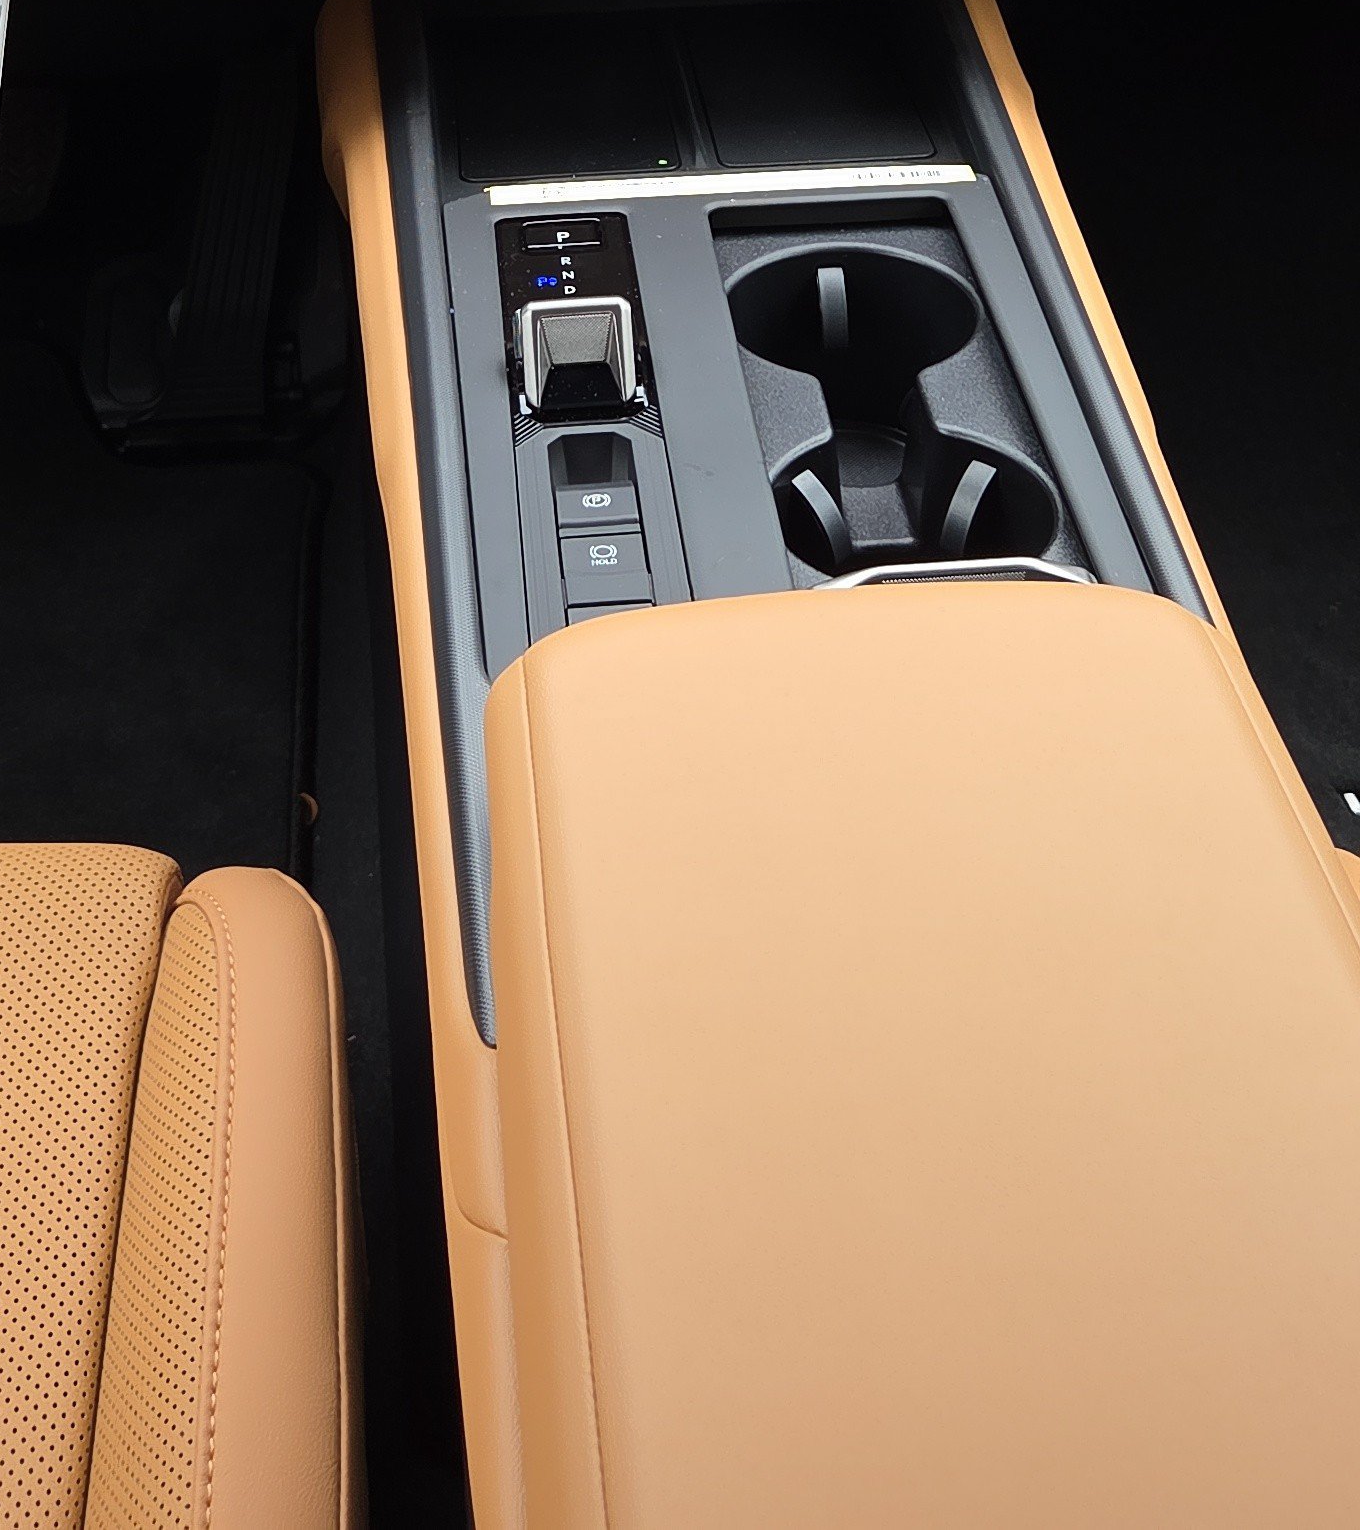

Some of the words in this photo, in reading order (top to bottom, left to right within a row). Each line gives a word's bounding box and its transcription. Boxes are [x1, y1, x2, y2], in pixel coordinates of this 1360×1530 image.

[556, 231, 570, 243] P
[560, 256, 572, 265] R
[562, 270, 575, 280] N
[564, 285, 577, 295] D
[590, 558, 618, 567] HOLD
